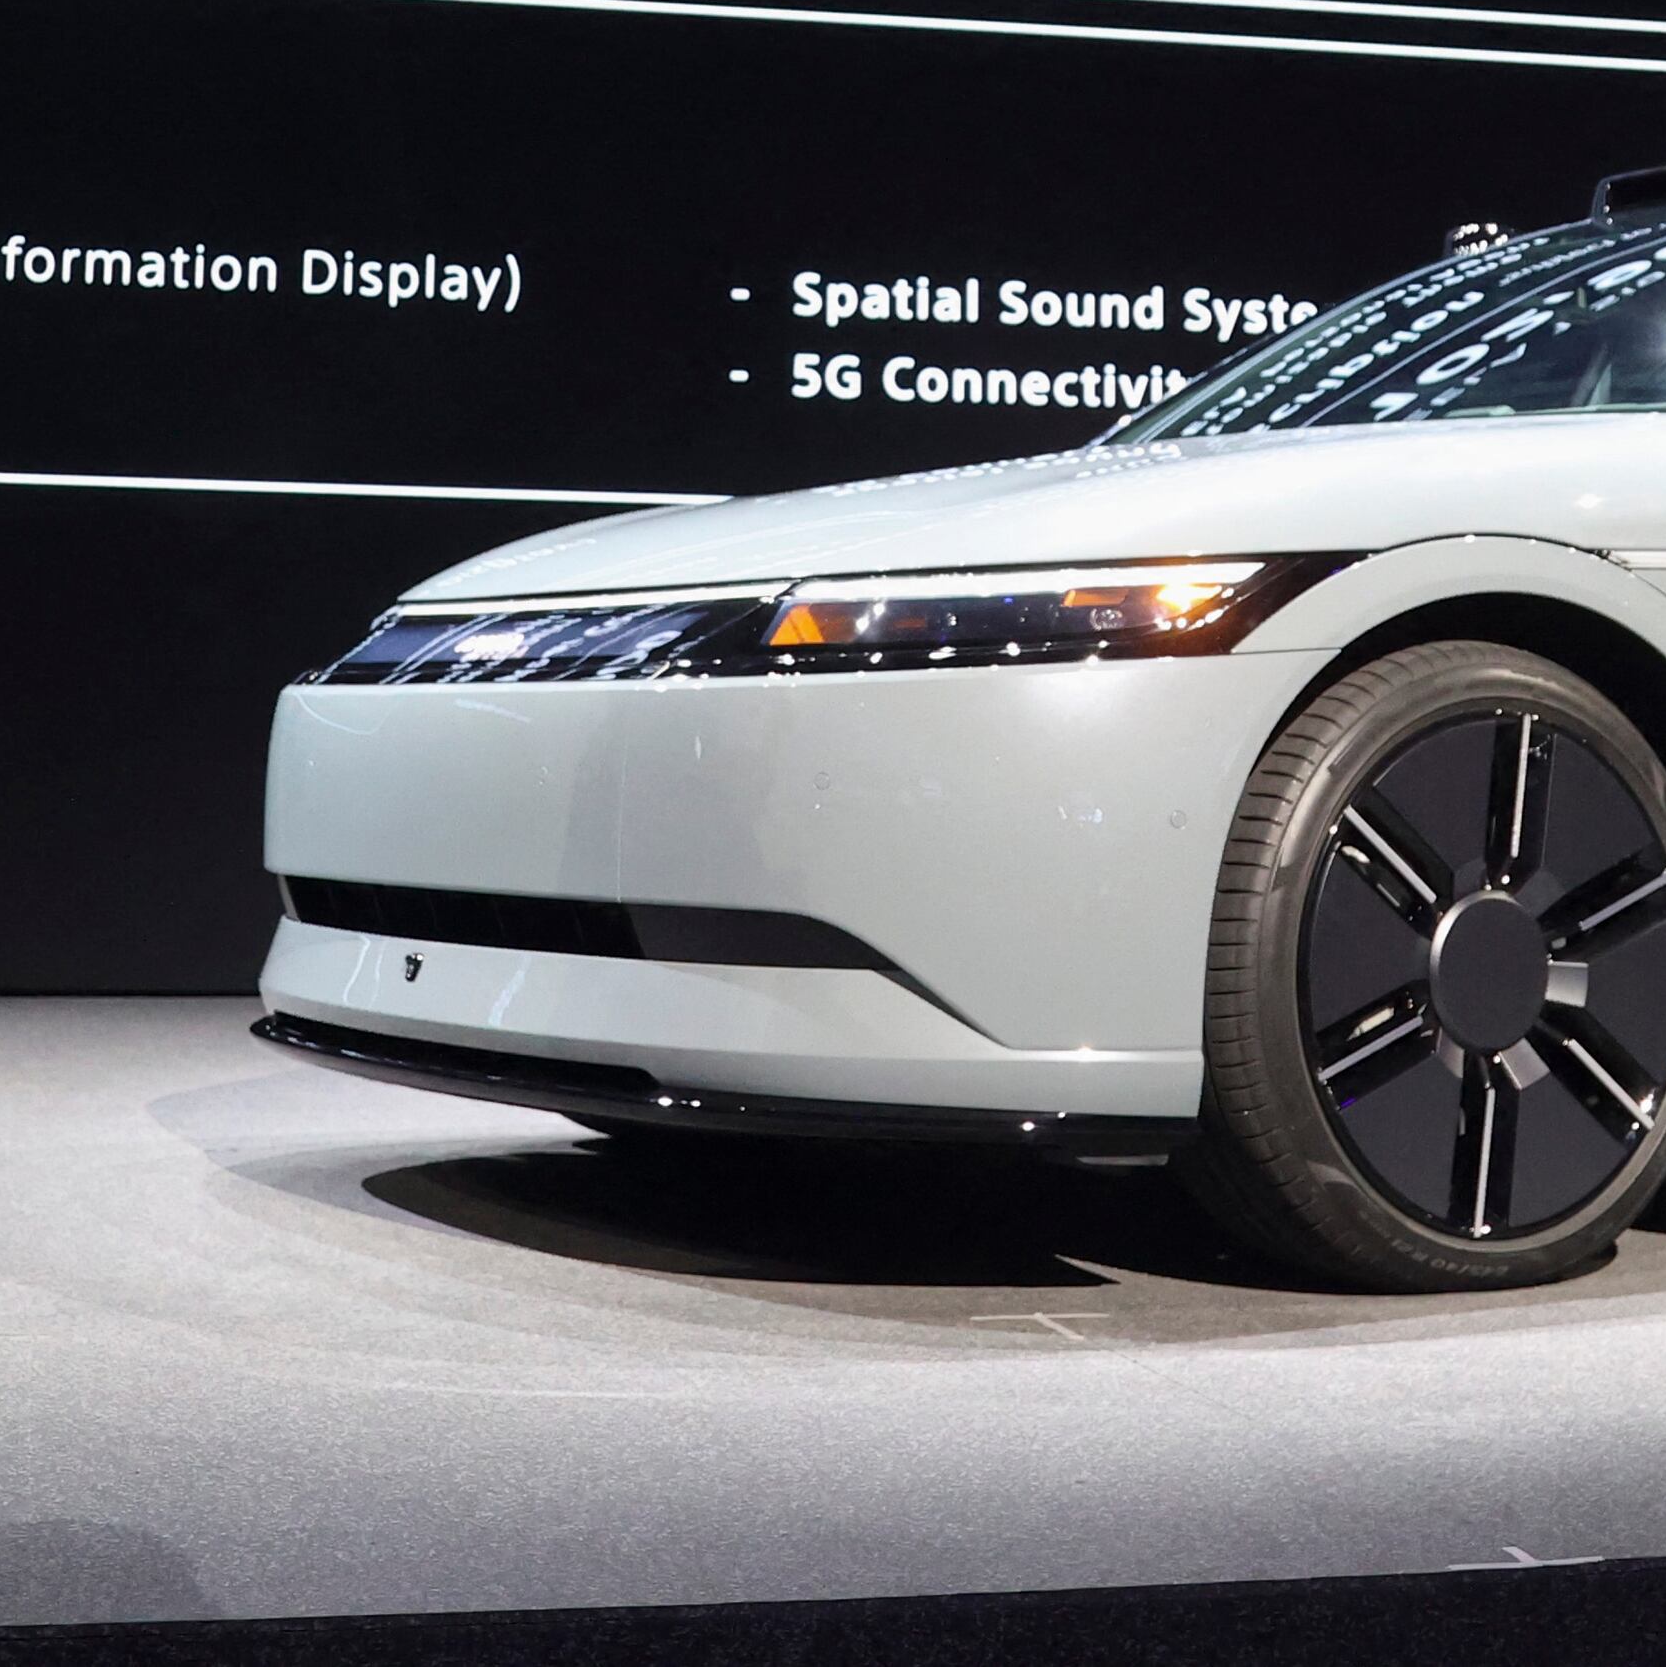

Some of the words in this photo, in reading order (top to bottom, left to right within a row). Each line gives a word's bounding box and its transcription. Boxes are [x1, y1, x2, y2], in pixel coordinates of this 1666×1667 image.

[302, 249, 521, 313] Display)
[792, 271, 979, 327] Spatial
[999, 280, 1164, 330] Sound
[1183, 287, 1318, 343] Syste
[791, 352, 862, 400] 5G
[882, 356, 1186, 409] Connectivit
